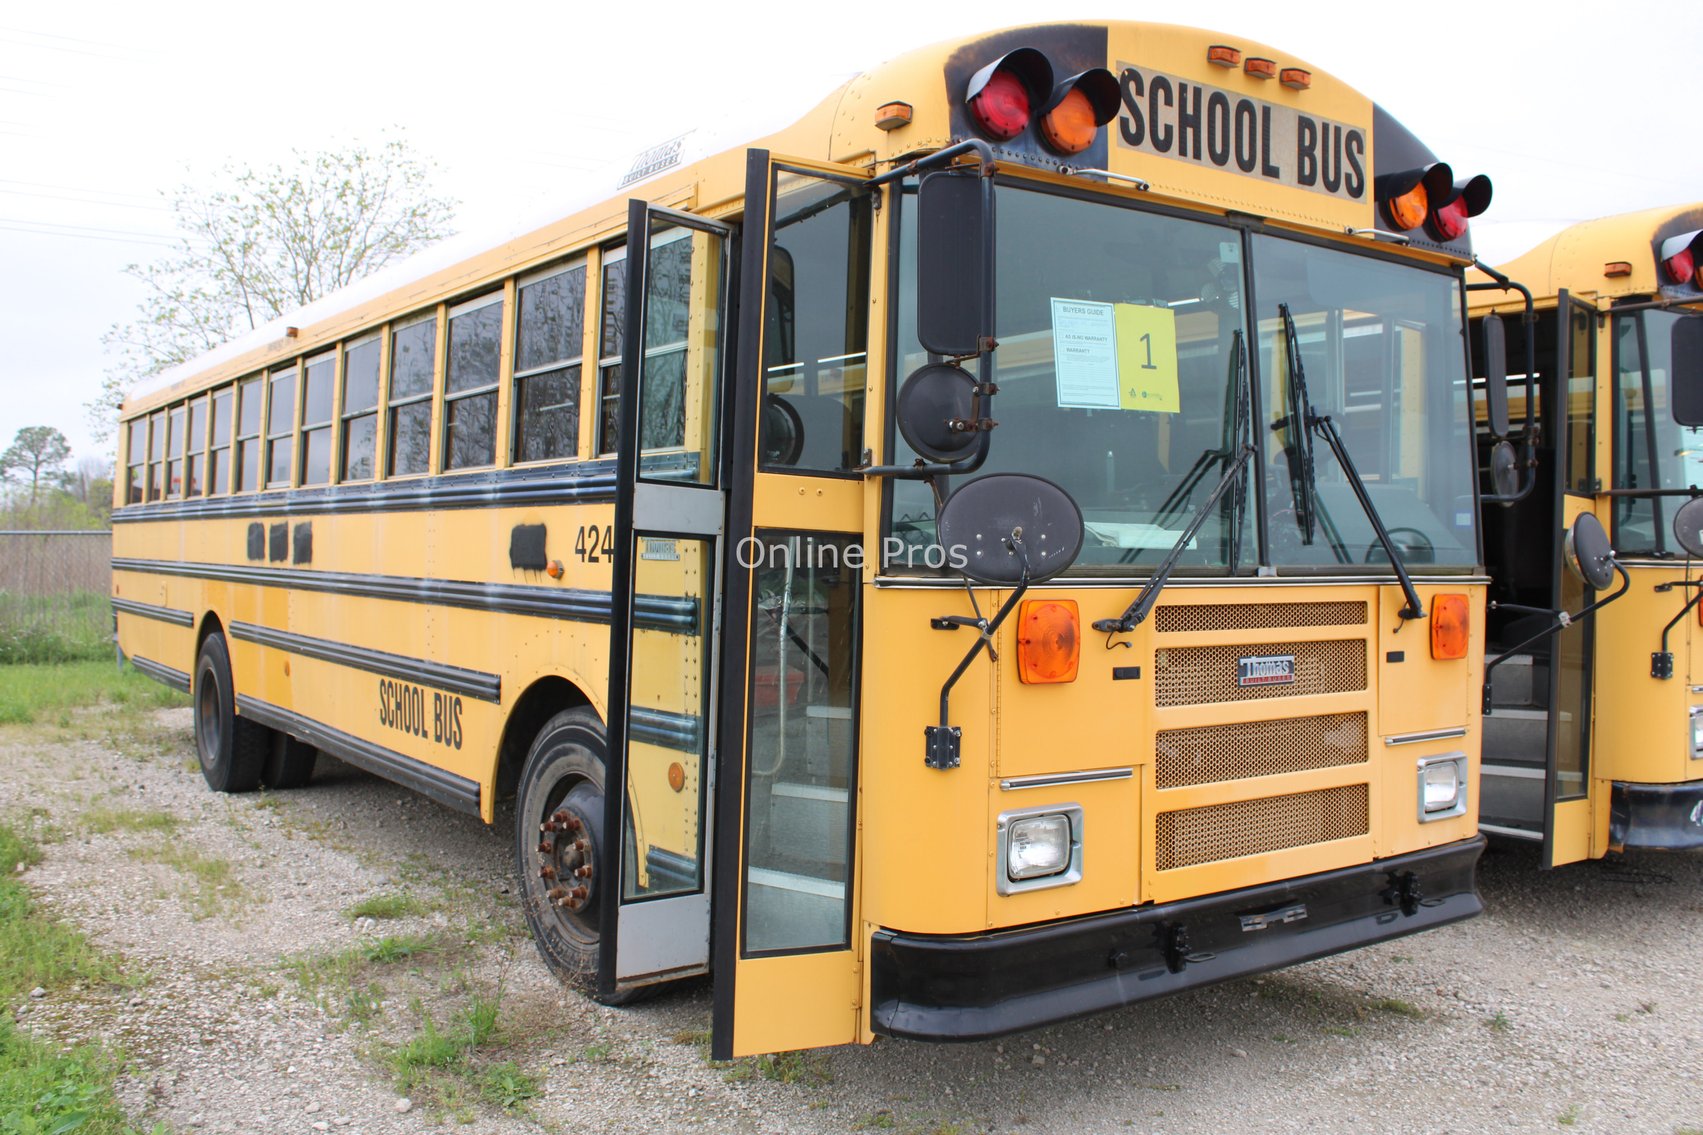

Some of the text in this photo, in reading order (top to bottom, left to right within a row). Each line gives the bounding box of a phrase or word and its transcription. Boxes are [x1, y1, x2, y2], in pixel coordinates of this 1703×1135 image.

[1119, 67, 1365, 199] SCHOOL BUS
[1062, 306, 1104, 316] BUYERS GUIDE
[1140, 333, 1157, 370] 1
[575, 524, 614, 563] 424
[1240, 656, 1294, 677] Thomas
[379, 678, 463, 750] SCHOOL BUS
